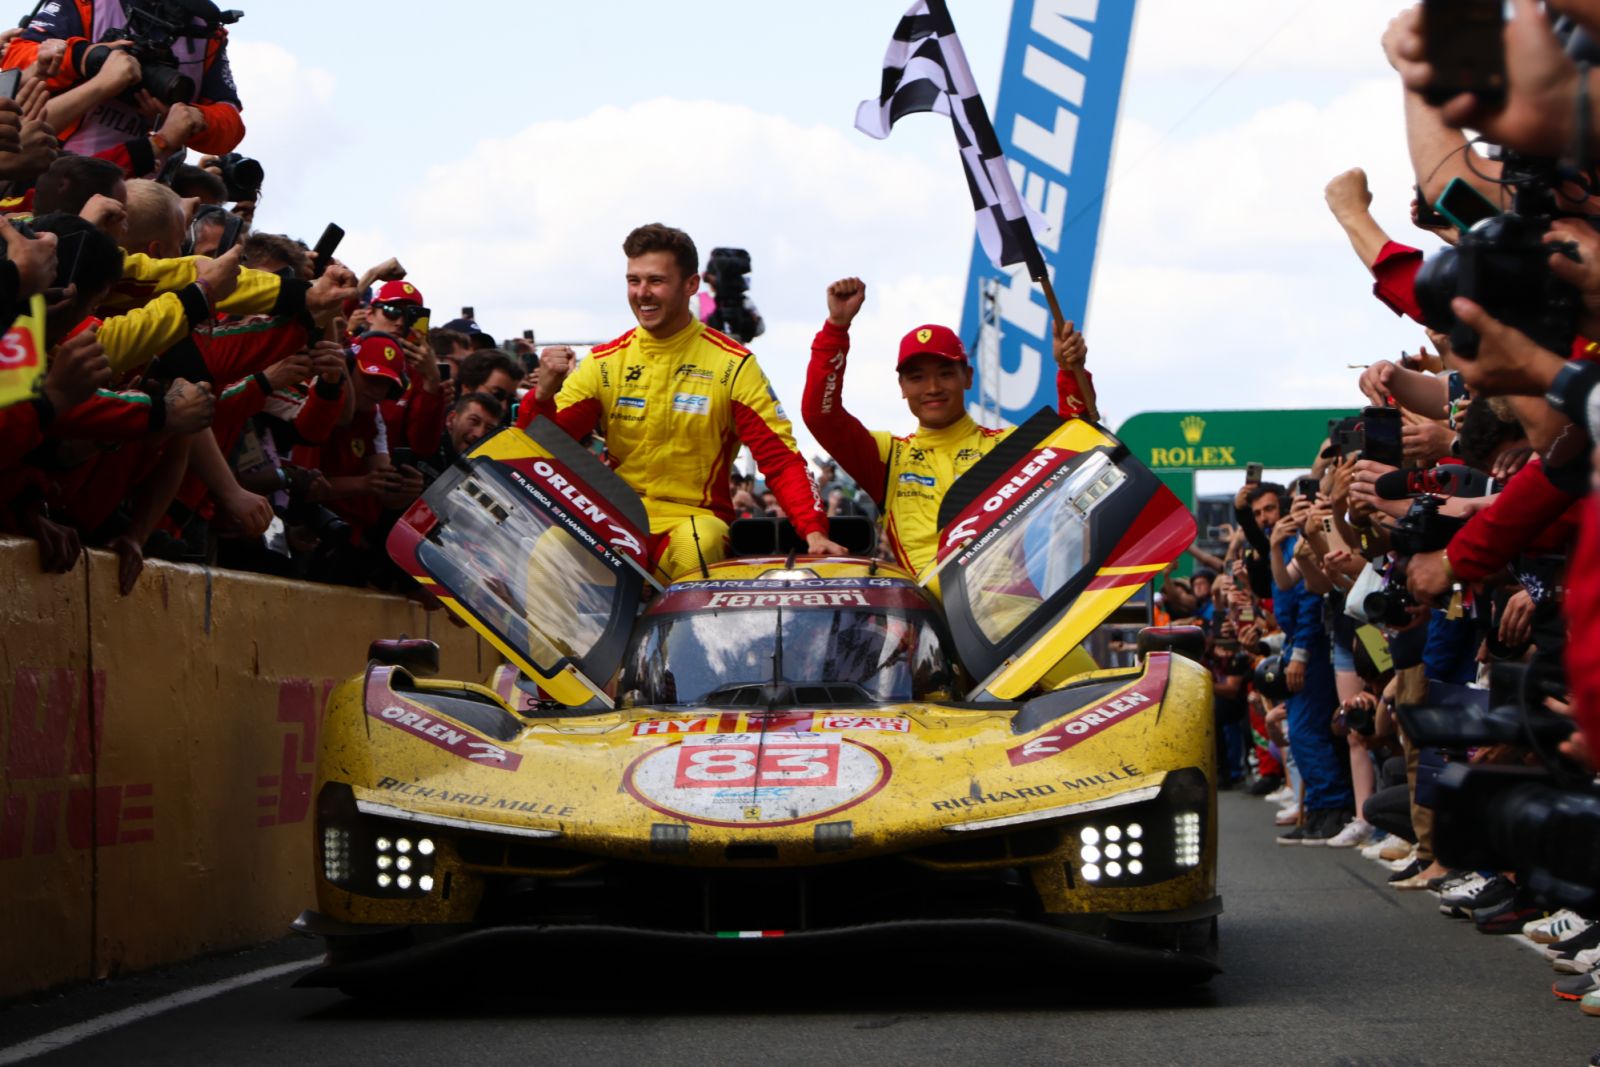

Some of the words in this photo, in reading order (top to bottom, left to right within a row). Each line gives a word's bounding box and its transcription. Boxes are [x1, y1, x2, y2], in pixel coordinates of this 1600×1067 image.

[970, 0, 1101, 428] CHELIN
[821, 372, 837, 414] ORLEN
[1151, 446, 1237, 467] ROLEX
[533, 461, 610, 524] ORLEN
[983, 447, 1058, 513] ORLEN
[525, 481, 552, 508] KUBICA
[565, 517, 597, 546] HANSON
[610, 555, 623, 567] YE
[973, 528, 1001, 555] KUBICA
[1014, 487, 1045, 516] HANSON
[678, 580, 785, 591] CHARLES
[790, 579, 862, 588] POZZI
[703, 590, 871, 609] Ferrari
[381, 706, 467, 746] ORLEN
[637, 719, 701, 736] HY
[829, 720, 903, 731] CAR
[1064, 691, 1151, 736] ORLEN
[684, 748, 830, 782] 83
[376, 776, 490, 807] RICHARD
[493, 798, 577, 817] MILLE
[931, 784, 1056, 812] RICHARD
[1061, 763, 1143, 791] MILLE
